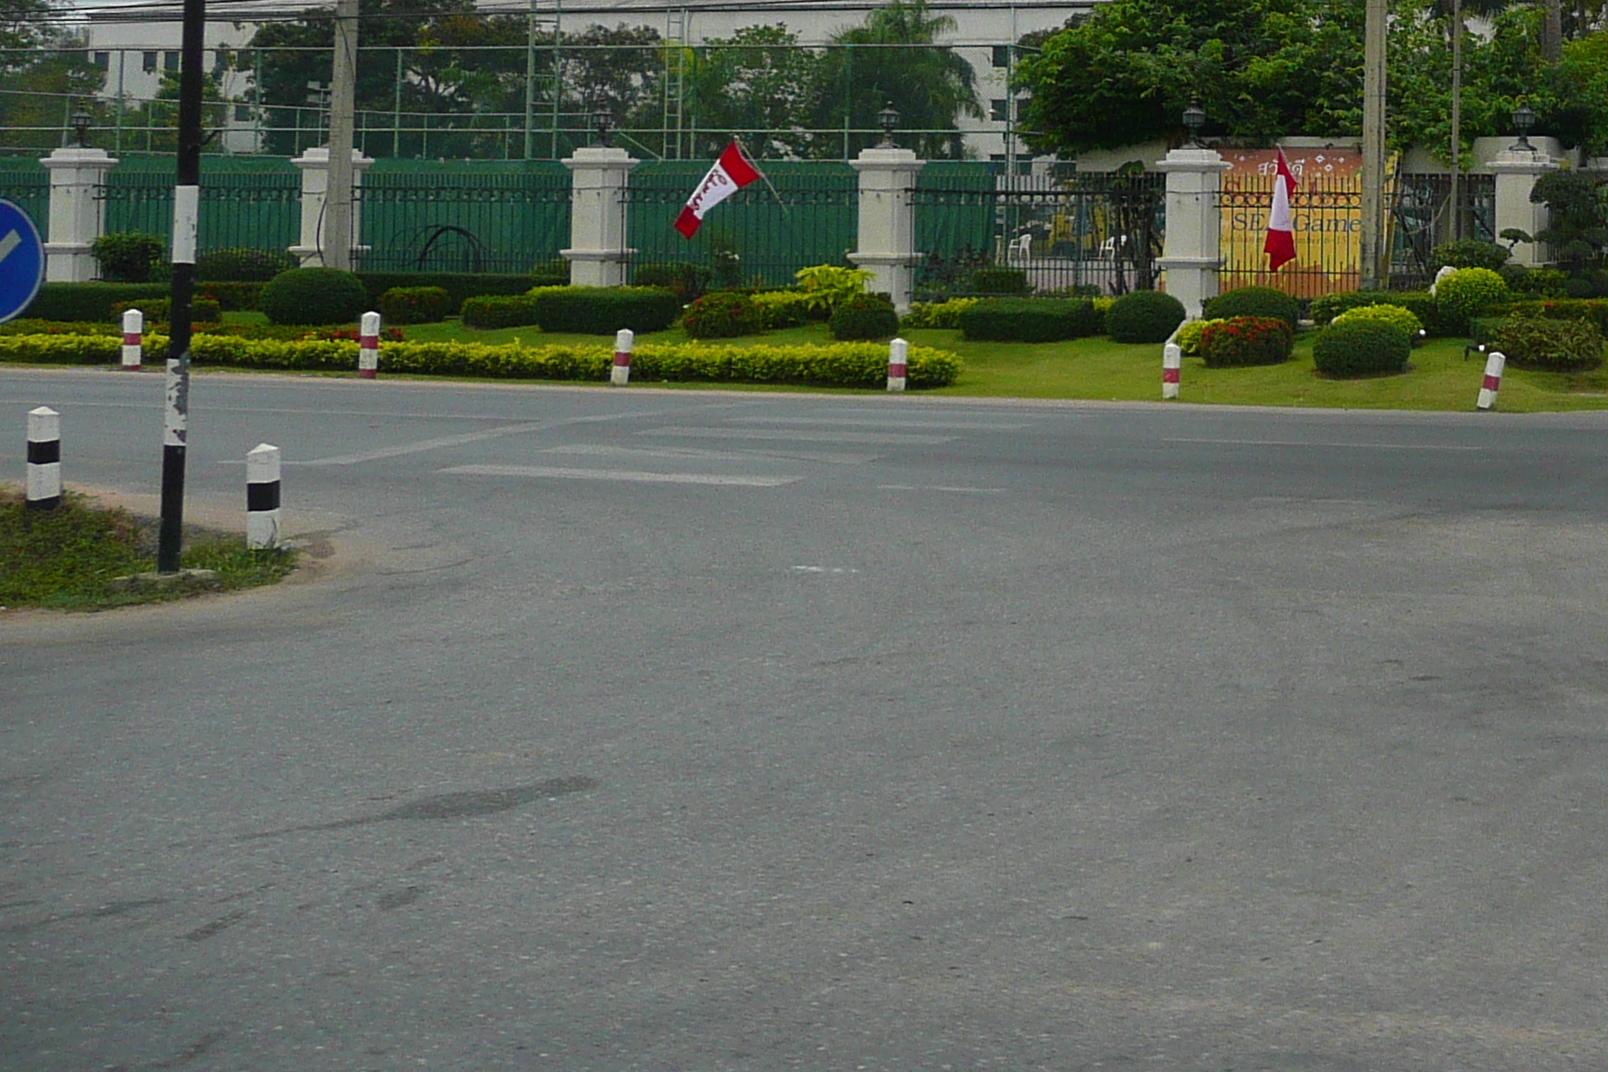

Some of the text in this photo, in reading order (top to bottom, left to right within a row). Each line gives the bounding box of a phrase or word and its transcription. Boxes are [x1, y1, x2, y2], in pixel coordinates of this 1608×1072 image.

[1258, 159, 1305, 176] สวัดี
[1233, 212, 1361, 233] SE Game
